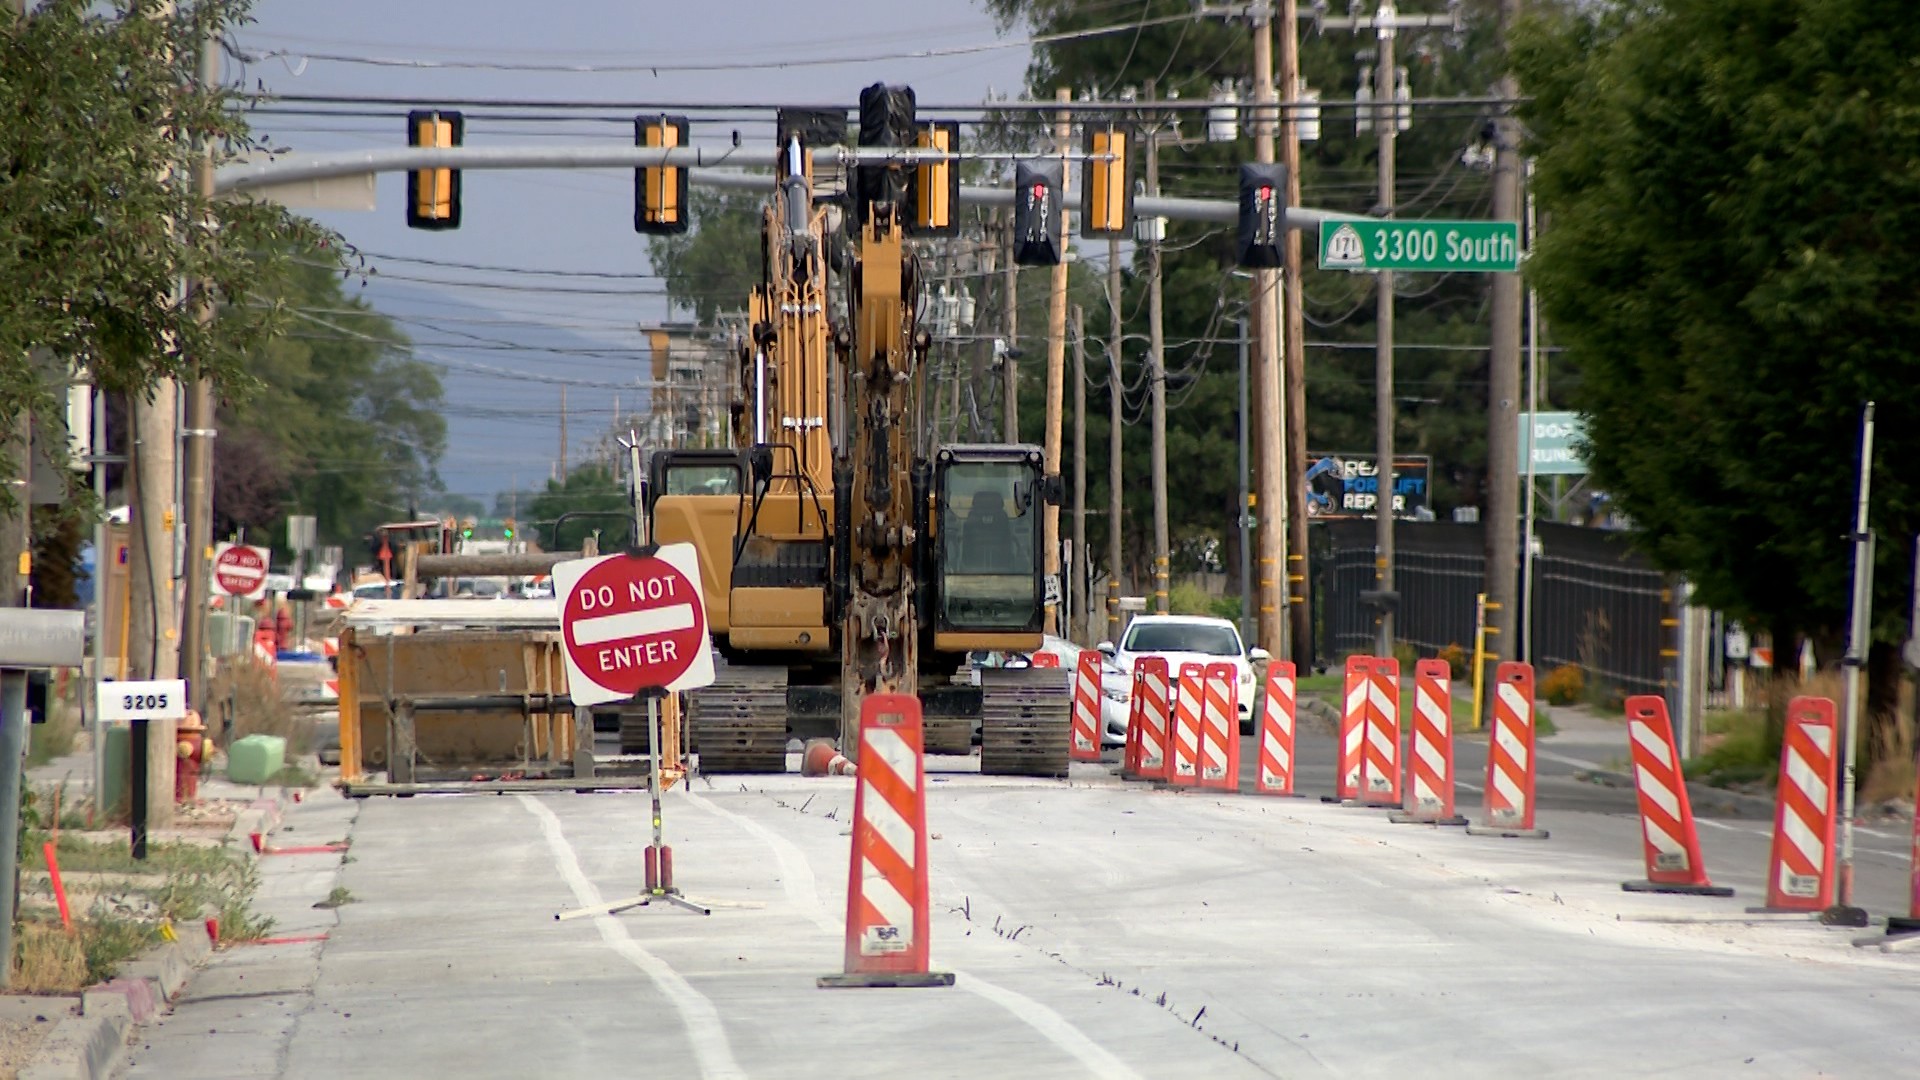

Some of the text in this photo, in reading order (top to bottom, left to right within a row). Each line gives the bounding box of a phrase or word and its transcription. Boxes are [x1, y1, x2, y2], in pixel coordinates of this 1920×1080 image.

[1335, 236, 1356, 252] 171
[1373, 229, 1515, 262] 3300 South
[579, 575, 676, 610] DO NOT
[598, 640, 678, 671] ENTER
[123, 695, 167, 710] 3205
